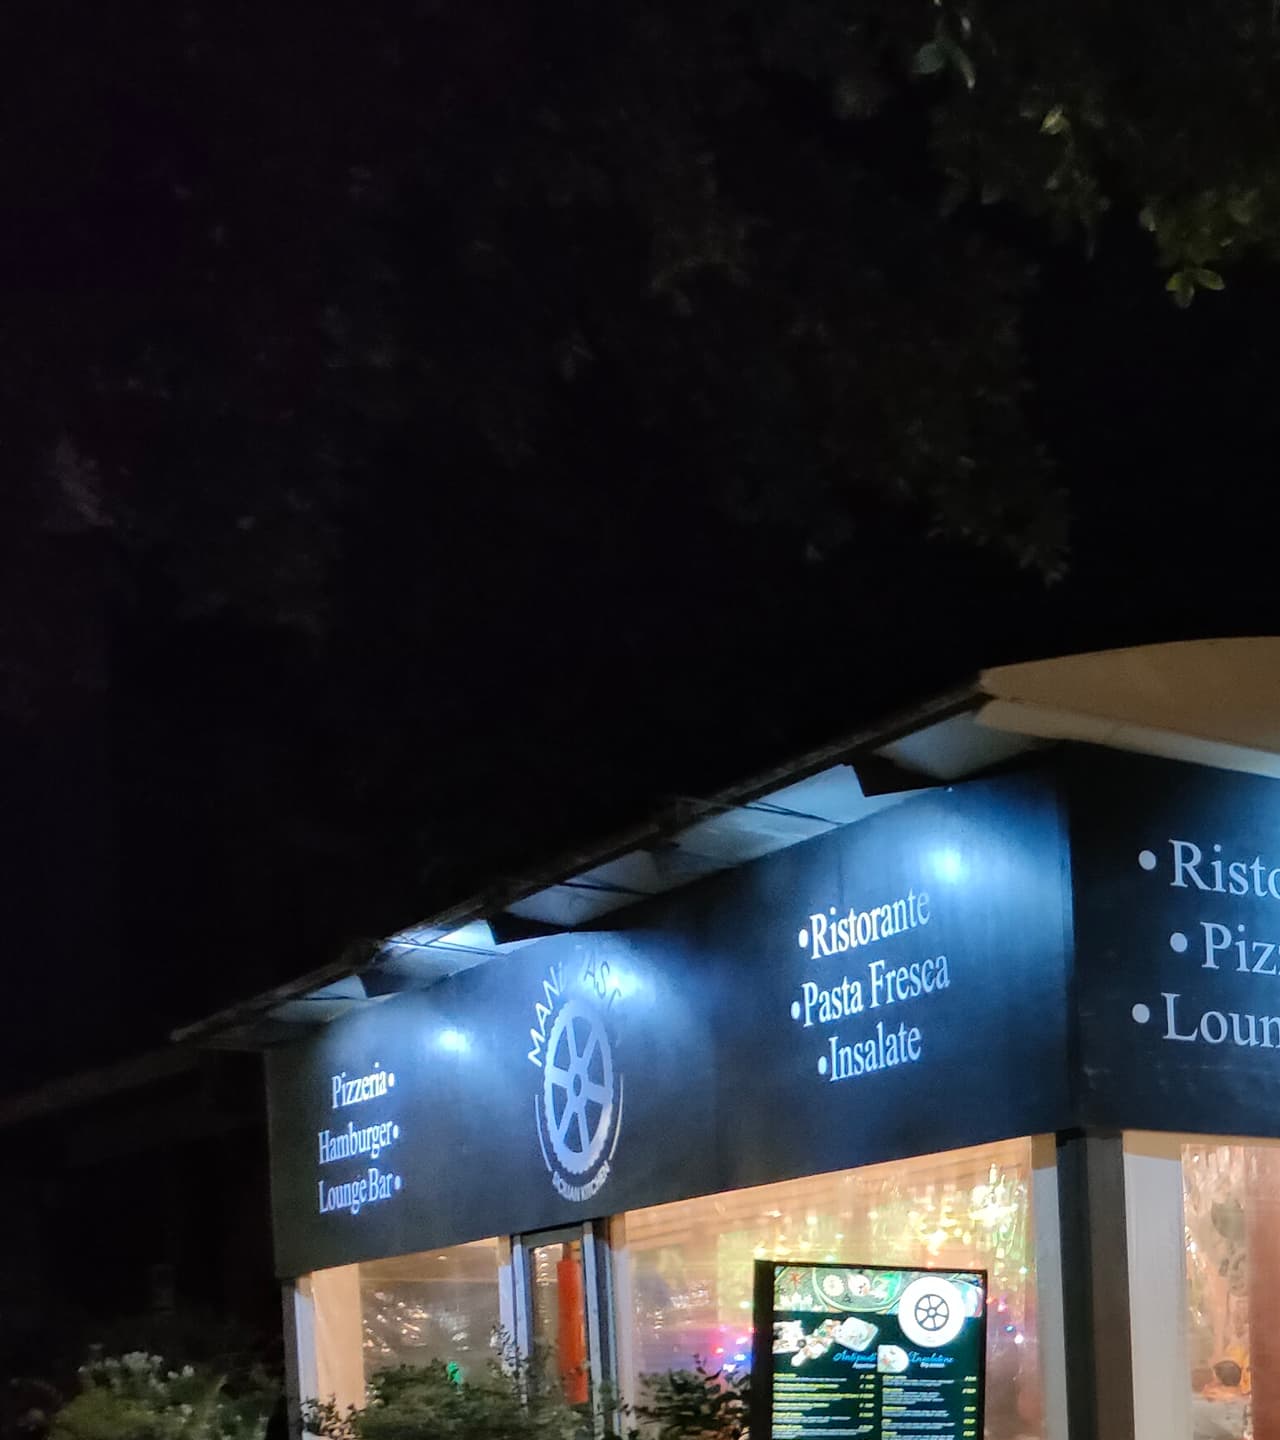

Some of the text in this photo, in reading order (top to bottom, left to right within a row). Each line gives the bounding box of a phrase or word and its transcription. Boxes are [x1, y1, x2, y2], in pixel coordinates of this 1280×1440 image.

[809, 888, 930, 960] Ristorante
[802, 955, 950, 1027] Pasta Fresca
[829, 1021, 922, 1081] Insalate
[331, 1062, 387, 1109] Pizzeria
[318, 1121, 393, 1164] Hamburger
[318, 1168, 393, 1215] Lounge Bar
